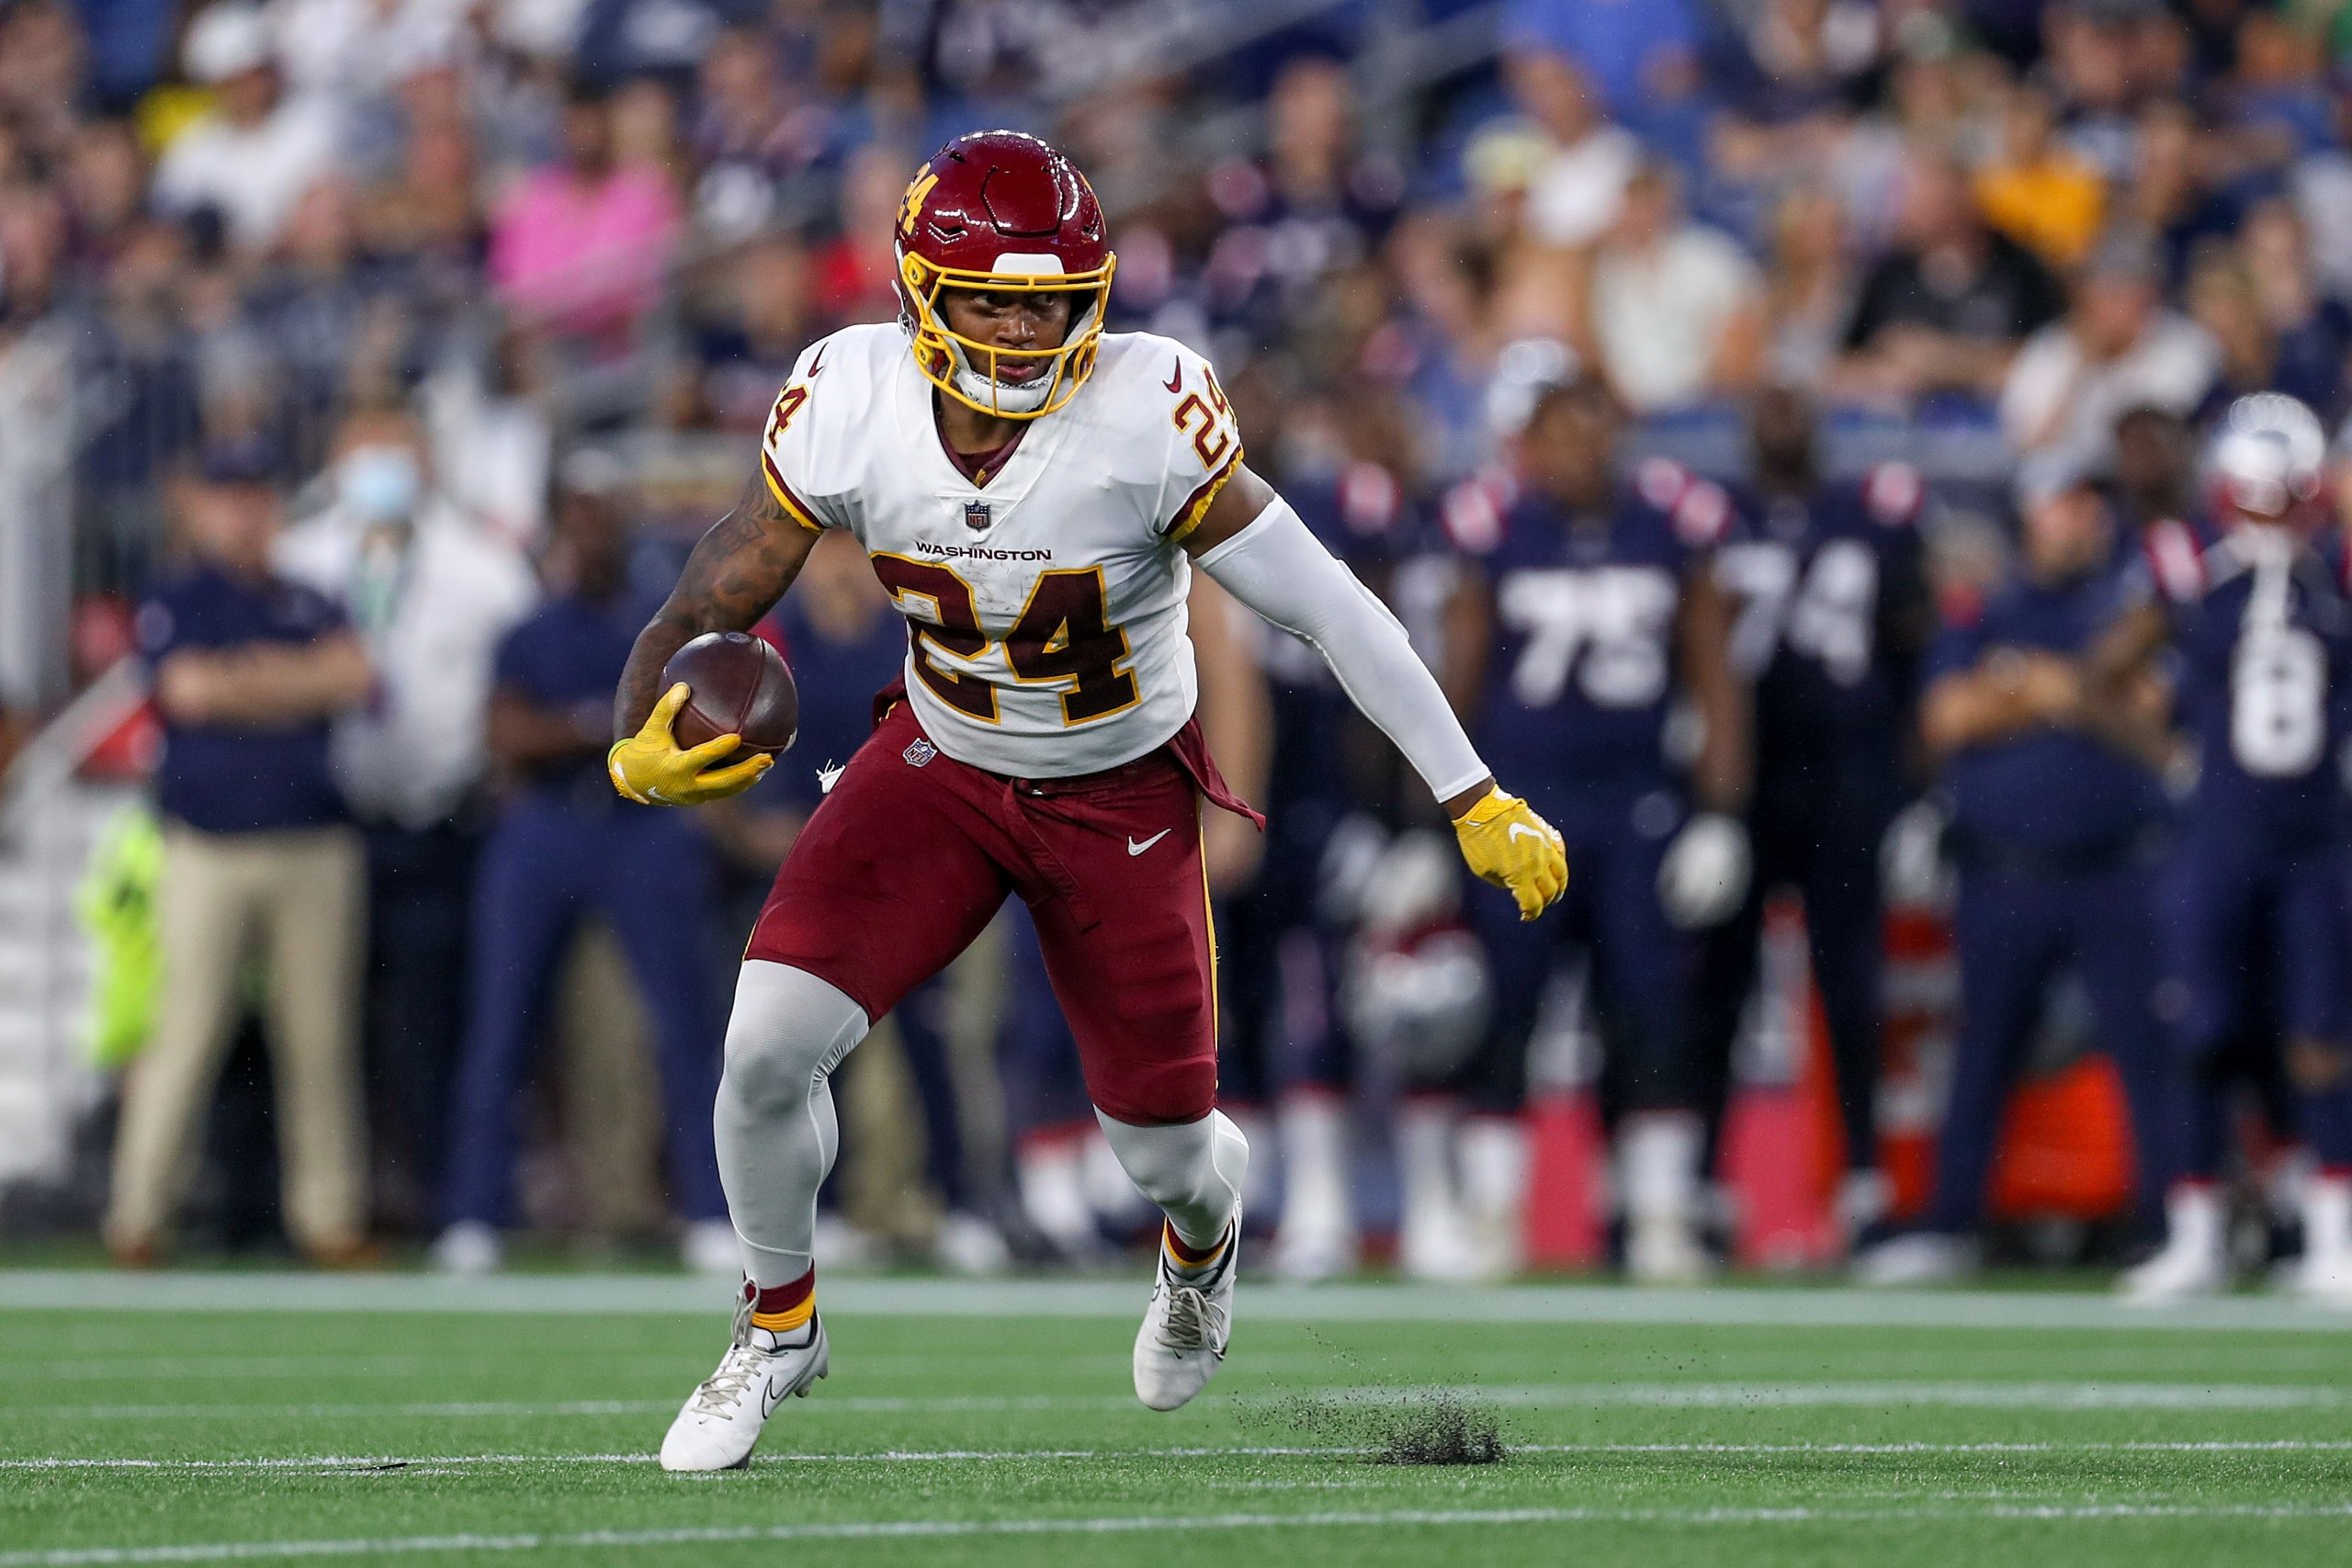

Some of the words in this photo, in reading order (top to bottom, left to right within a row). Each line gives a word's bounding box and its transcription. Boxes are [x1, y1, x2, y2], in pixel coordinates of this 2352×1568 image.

[766, 379, 810, 455] 4
[914, 541, 1052, 561] WASHINGTON
[968, 514, 988, 526] NFL
[869, 550, 1142, 728] 24
[1499, 564, 1678, 708] 75
[1711, 539, 1878, 685] 74
